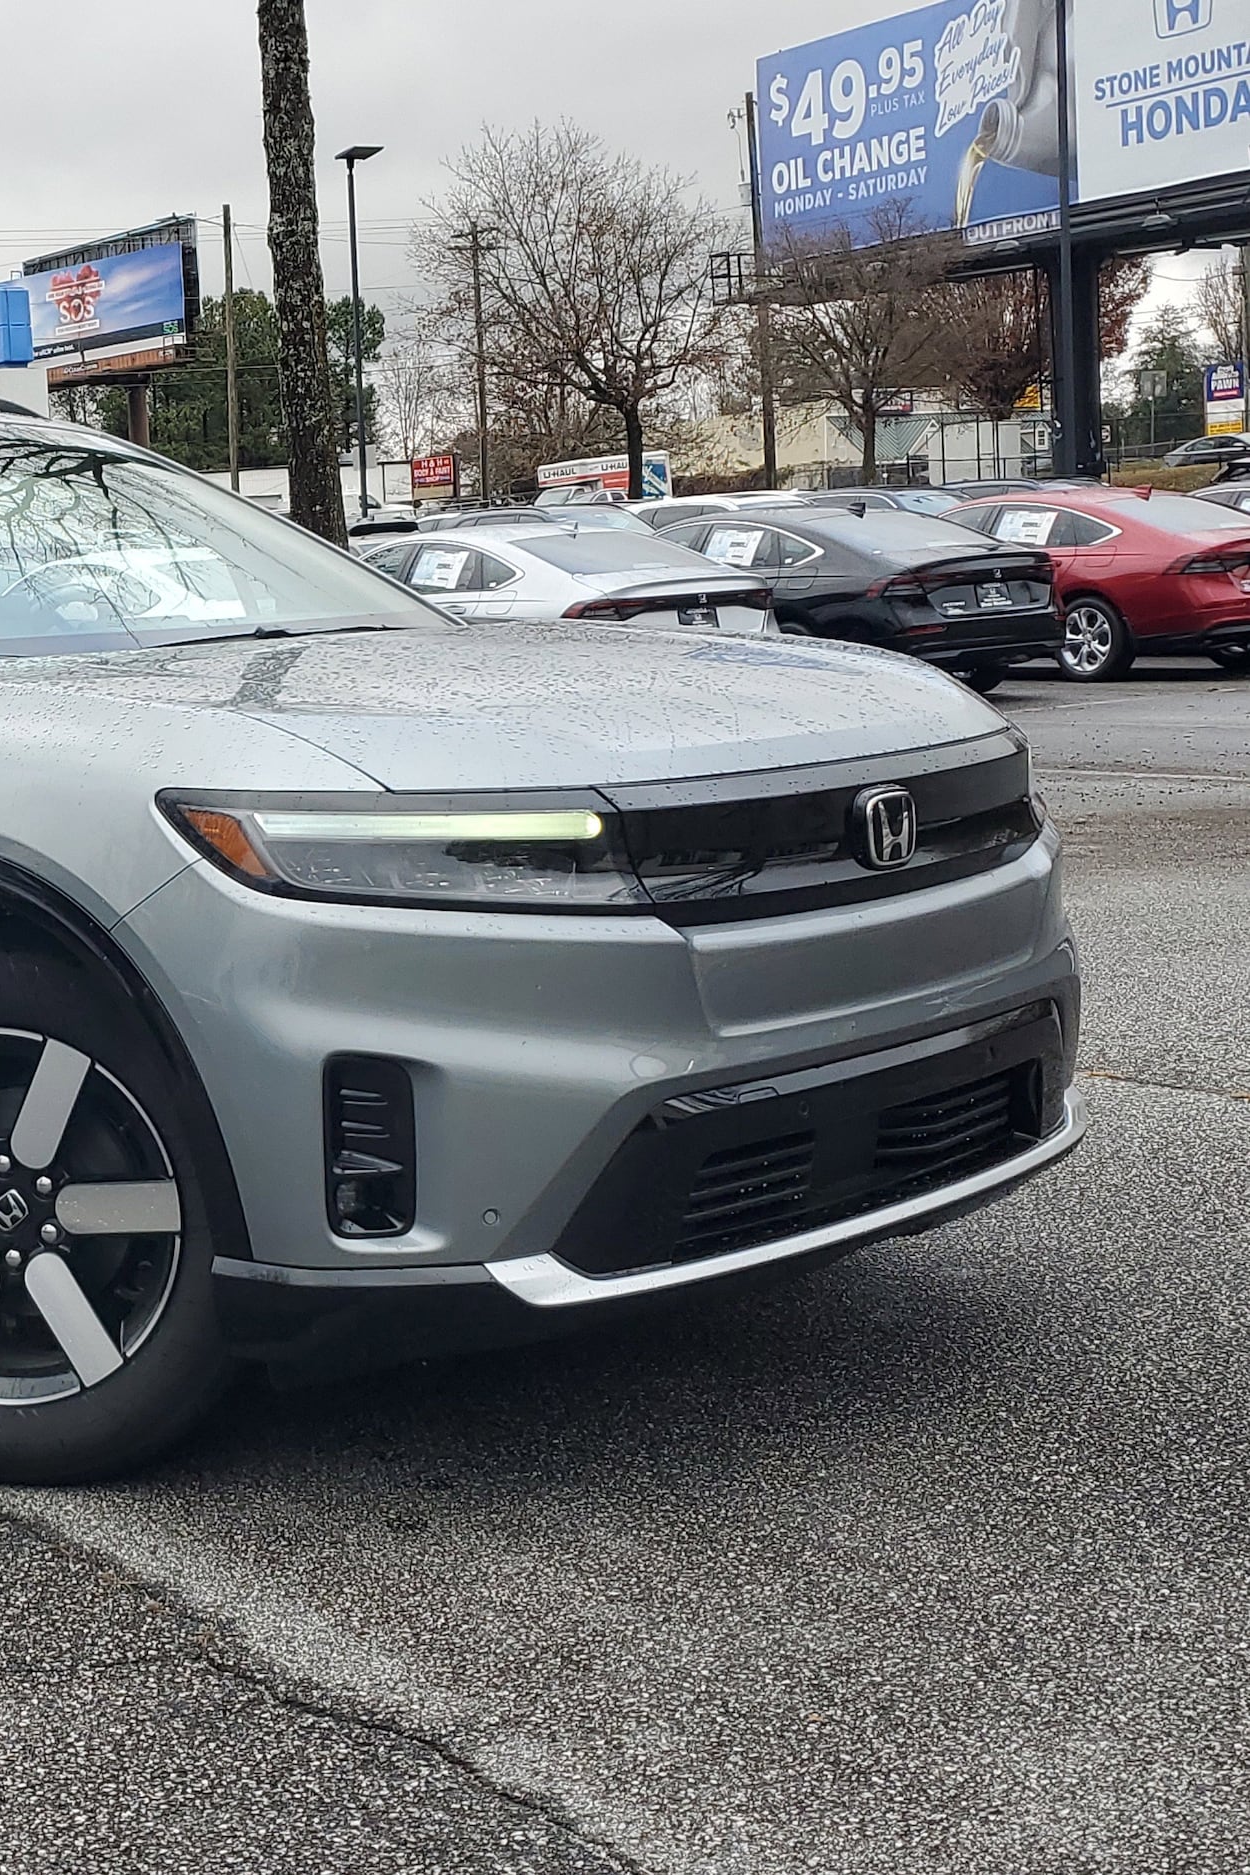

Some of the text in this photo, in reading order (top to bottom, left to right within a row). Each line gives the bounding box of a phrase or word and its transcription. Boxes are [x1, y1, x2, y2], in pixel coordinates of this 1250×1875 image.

[937, 1, 1000, 63] All Day
[938, 37, 1006, 97] Everyday
[1094, 64, 1161, 101] STONE
[769, 39, 925, 146] $49.95
[870, 90, 926, 117] PLUS TAX
[938, 51, 1019, 131] Low Prices!
[1120, 80, 1250, 147] HONDA
[772, 126, 927, 195] OIL CHANGE
[774, 188, 833, 219] MONDAY
[848, 166, 928, 201] SATURDAY
[966, 211, 1061, 241] OUTFRONT
[59, 295, 95, 323] SOS
[1211, 378, 1240, 391] PAWN
[543, 467, 577, 479] U-HAUL
[601, 461, 628, 472] U-HAU
